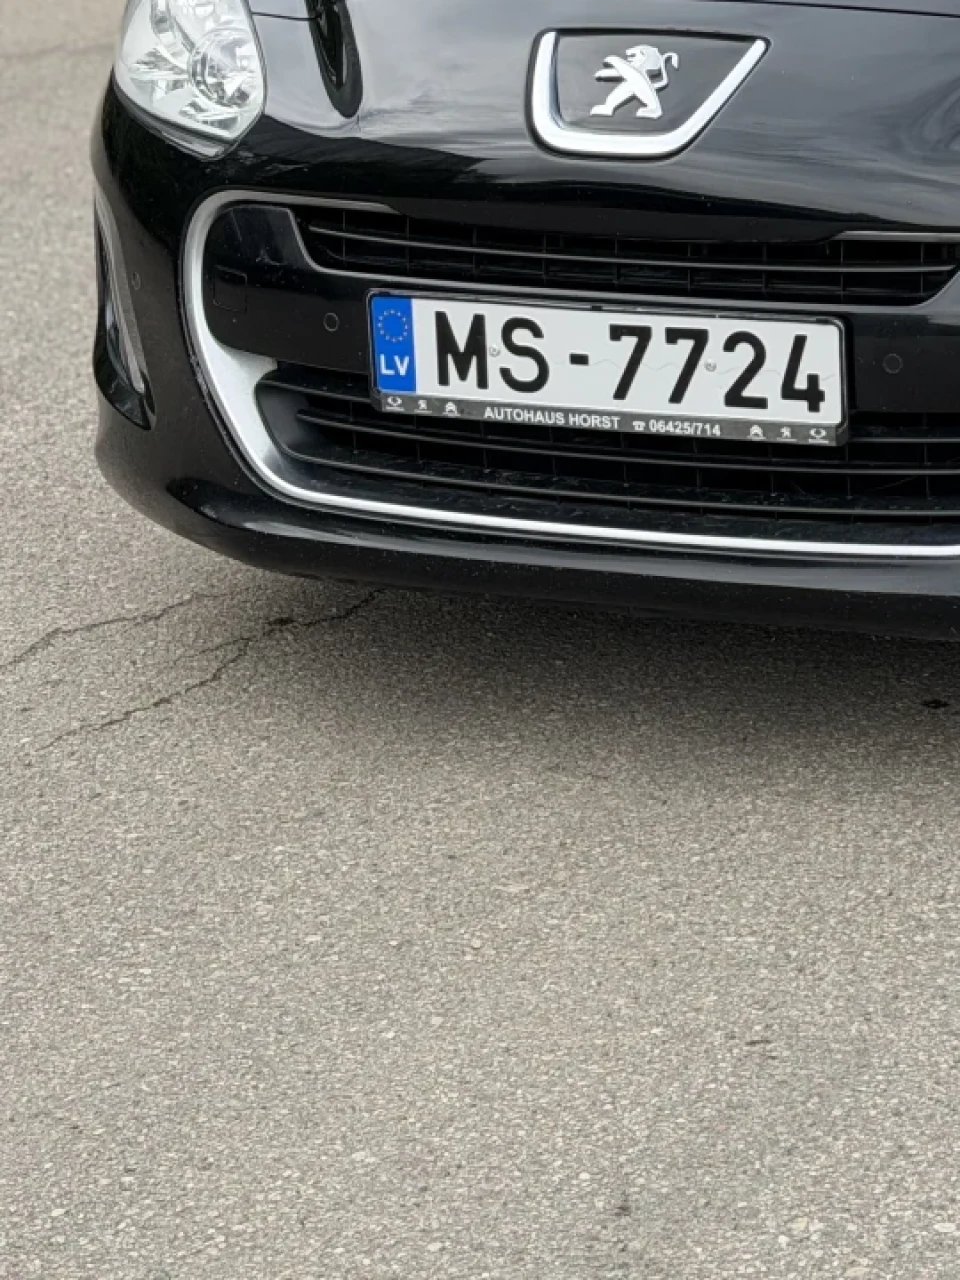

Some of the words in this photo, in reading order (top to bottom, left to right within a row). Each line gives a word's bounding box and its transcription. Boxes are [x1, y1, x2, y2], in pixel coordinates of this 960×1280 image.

[380, 354, 409, 376] LV
[435, 311, 826, 413] MS-7724
[483, 406, 565, 426] AUTOHAUS
[568, 413, 620, 429] HORST
[649, 419, 721, 437] 06425/714
